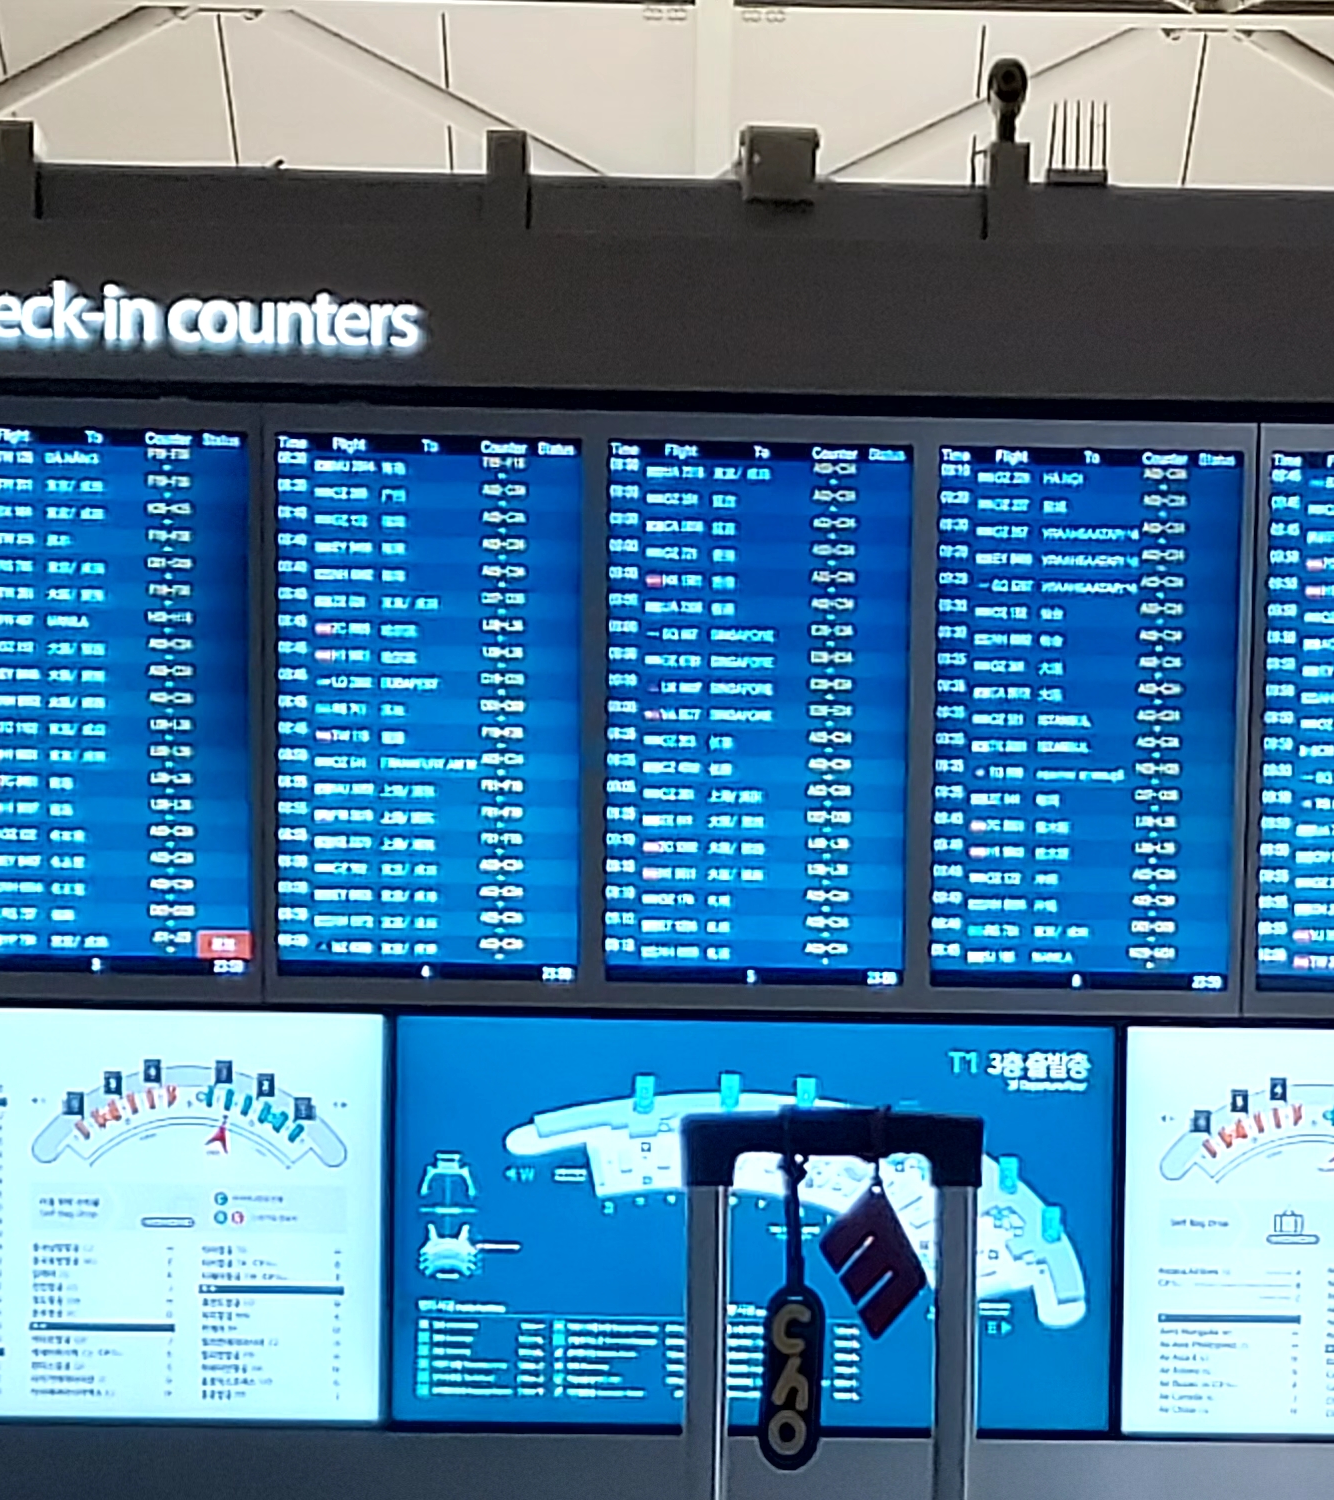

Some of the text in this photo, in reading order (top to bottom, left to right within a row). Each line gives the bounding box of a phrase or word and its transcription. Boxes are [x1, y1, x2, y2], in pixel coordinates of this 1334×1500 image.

[167, 298, 422, 352] counters
[84, 429, 104, 444] To
[144, 431, 193, 446] Counter
[202, 432, 240, 447] Status
[278, 435, 575, 456] Time Flight To Counter Status
[610, 442, 906, 462] Time Flight To Counter Status
[941, 448, 1236, 466] Time Flight To Counter Status
[1271, 453, 1303, 468] Time
[420, 964, 431, 978] 4
[948, 1051, 1091, 1080] T1 3층 출발층
